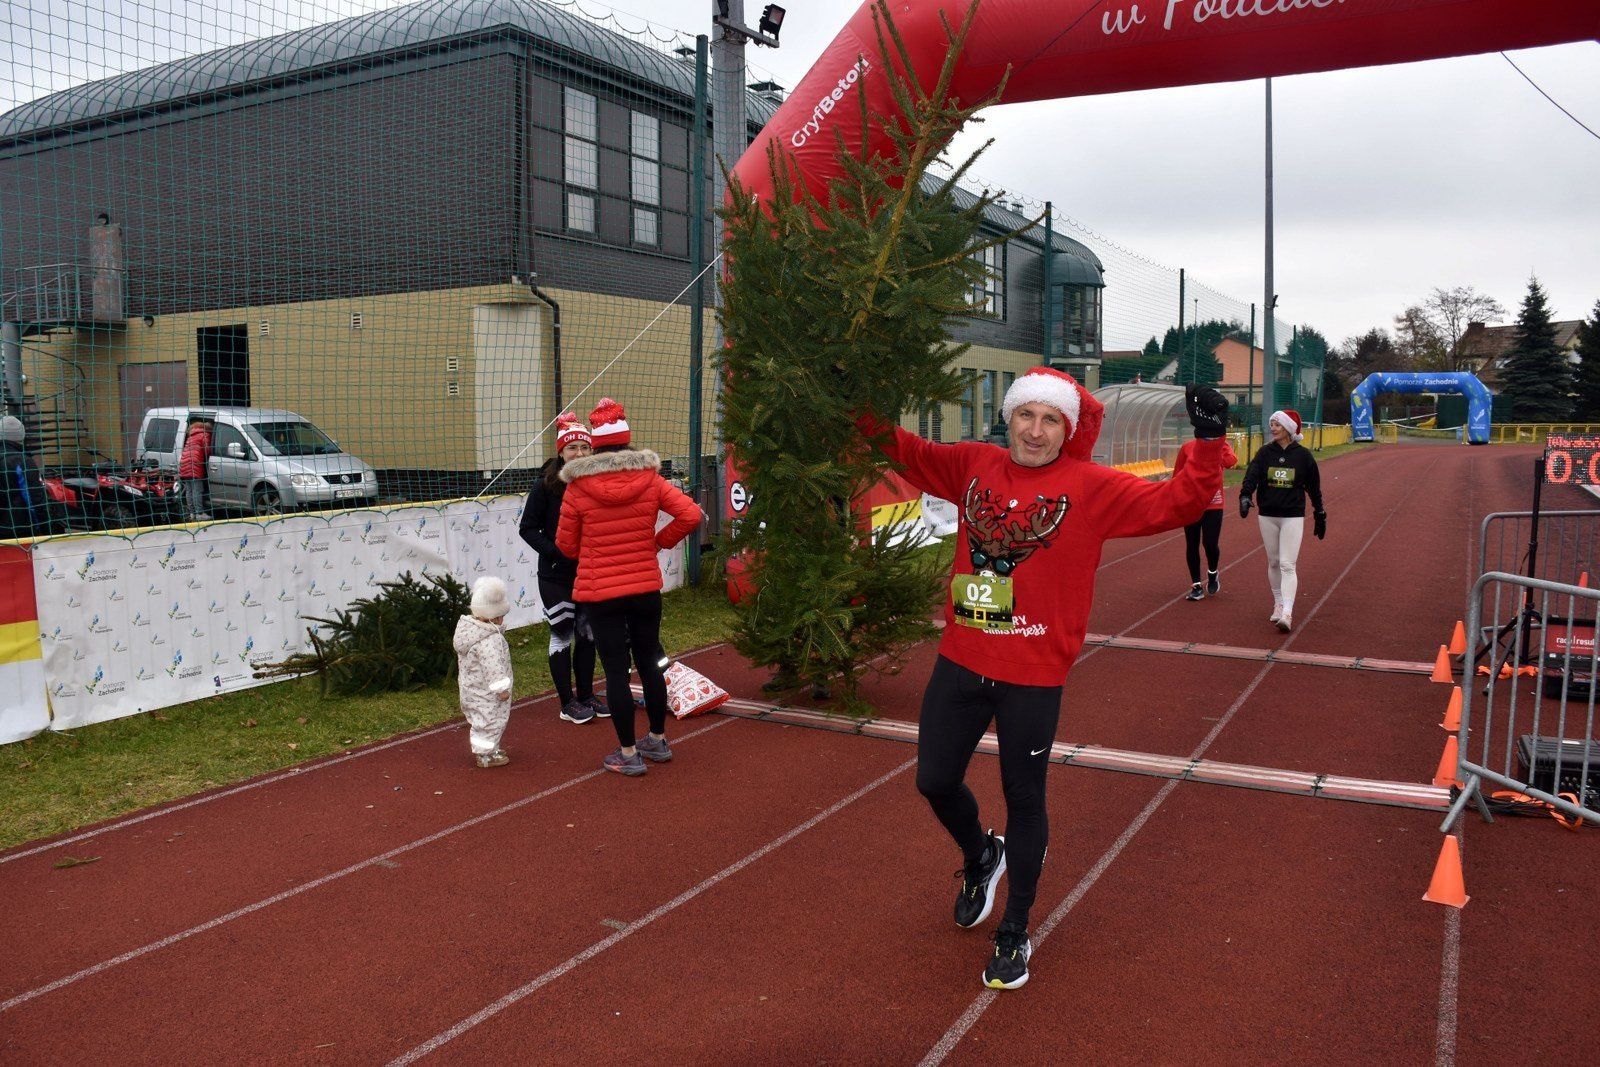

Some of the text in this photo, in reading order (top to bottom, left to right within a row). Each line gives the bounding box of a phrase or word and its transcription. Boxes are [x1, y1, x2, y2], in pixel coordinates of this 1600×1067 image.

[1102, 5, 1146, 35] w
[791, 58, 870, 148] GryfBeton
[1393, 378, 1459, 386] Pomorze Zachodnie
[563, 433, 576, 443] OH
[1274, 470, 1287, 478] 02
[170, 564, 195, 572] Zachodnie
[89, 574, 117, 583] Zachodnie
[966, 583, 992, 602] 02
[98, 686, 125, 697] Zachodnie
